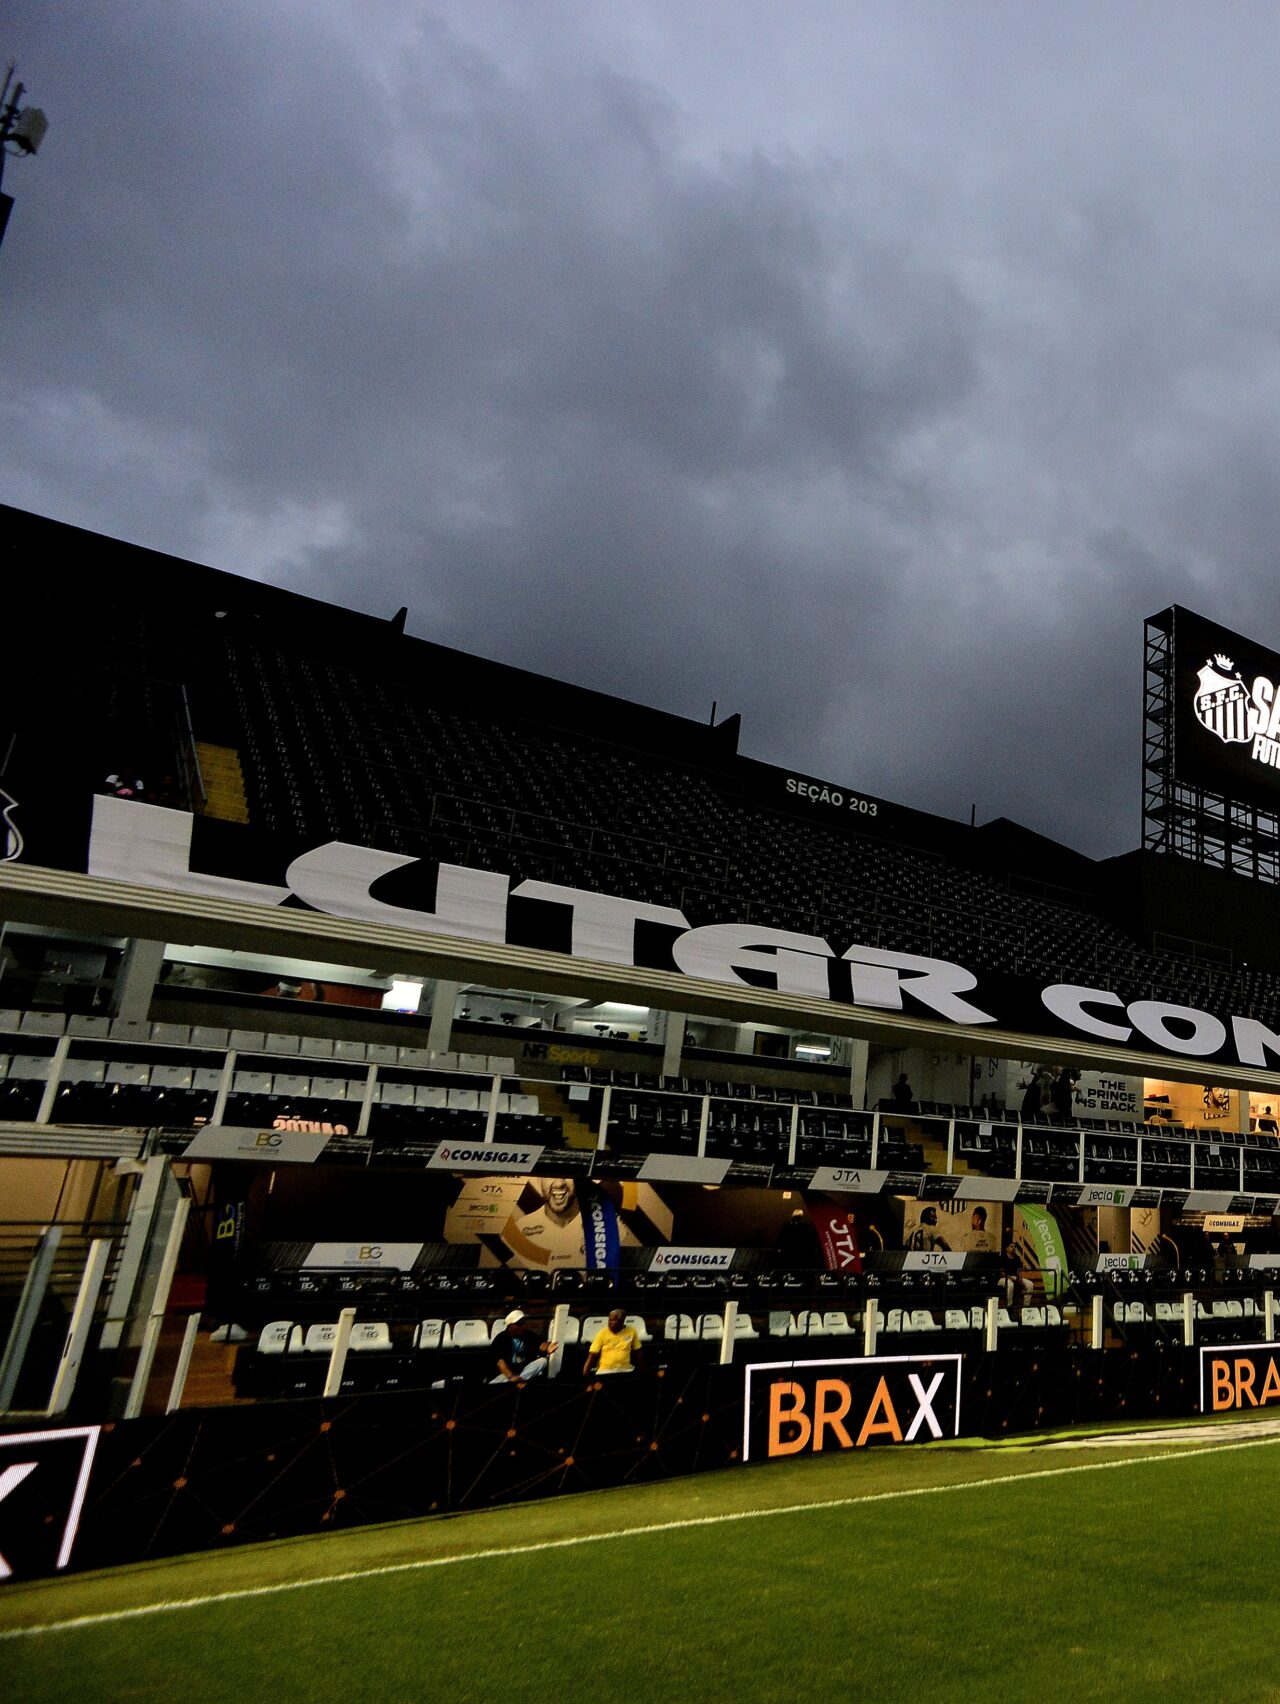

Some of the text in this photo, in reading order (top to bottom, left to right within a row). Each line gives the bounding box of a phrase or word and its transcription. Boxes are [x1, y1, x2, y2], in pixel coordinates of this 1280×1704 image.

[786, 778, 879, 817] SEÇÃO 203
[548, 1044, 601, 1066] Sports
[1099, 1080, 1126, 1091] THE
[1087, 1088, 1137, 1103] PRINCE
[1101, 1101, 1139, 1113] BACK.
[255, 1133, 282, 1147] BG
[450, 1149, 530, 1164] CONSIGAZ
[832, 1170, 861, 1182] JTA
[1089, 1190, 1113, 1201] tecla
[829, 1218, 856, 1269] JTA
[1034, 1220, 1056, 1257] tecla
[359, 1246, 383, 1260] BG
[664, 1254, 728, 1265] CONSIGAZ
[921, 1254, 948, 1265] JTA
[1104, 1256, 1128, 1269] tecla
[768, 1372, 945, 1457] BRAX
